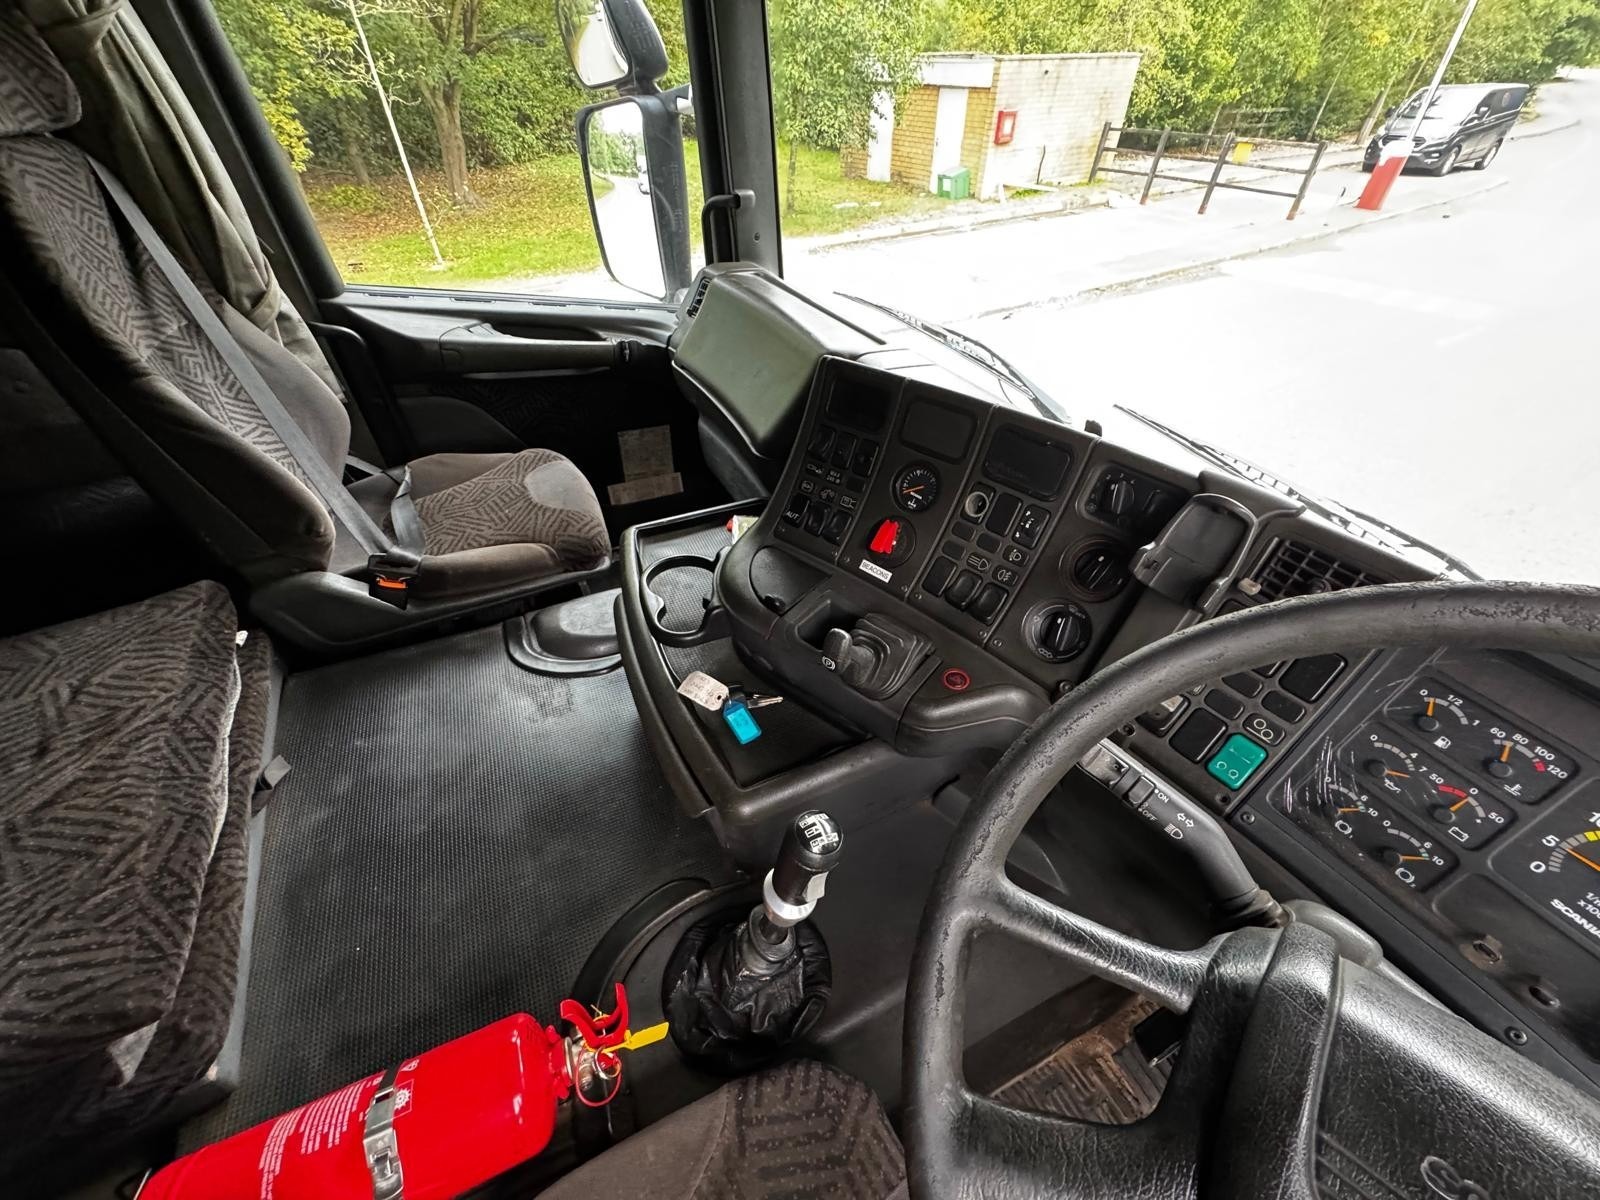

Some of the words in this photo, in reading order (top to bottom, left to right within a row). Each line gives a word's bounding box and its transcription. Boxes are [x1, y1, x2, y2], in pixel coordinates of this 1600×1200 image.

[861, 561, 890, 580] BEACONS
[1447, 694, 1464, 706] 1/2
[1490, 727, 1506, 738] 60
[1512, 733, 1529, 745] 80
[1533, 746, 1555, 761] 100
[1546, 764, 1568, 779] 120
[1157, 792, 1170, 803] ON
[1429, 773, 1444, 784] 50
[1469, 787, 1479, 795] 0
[1488, 811, 1505, 824] 50
[1142, 810, 1158, 820] OFF
[1367, 807, 1378, 817] 10
[1423, 841, 1432, 849] 6
[1431, 855, 1444, 866] 10
[1529, 861, 1547, 873] 0
[1541, 834, 1560, 847] 5
